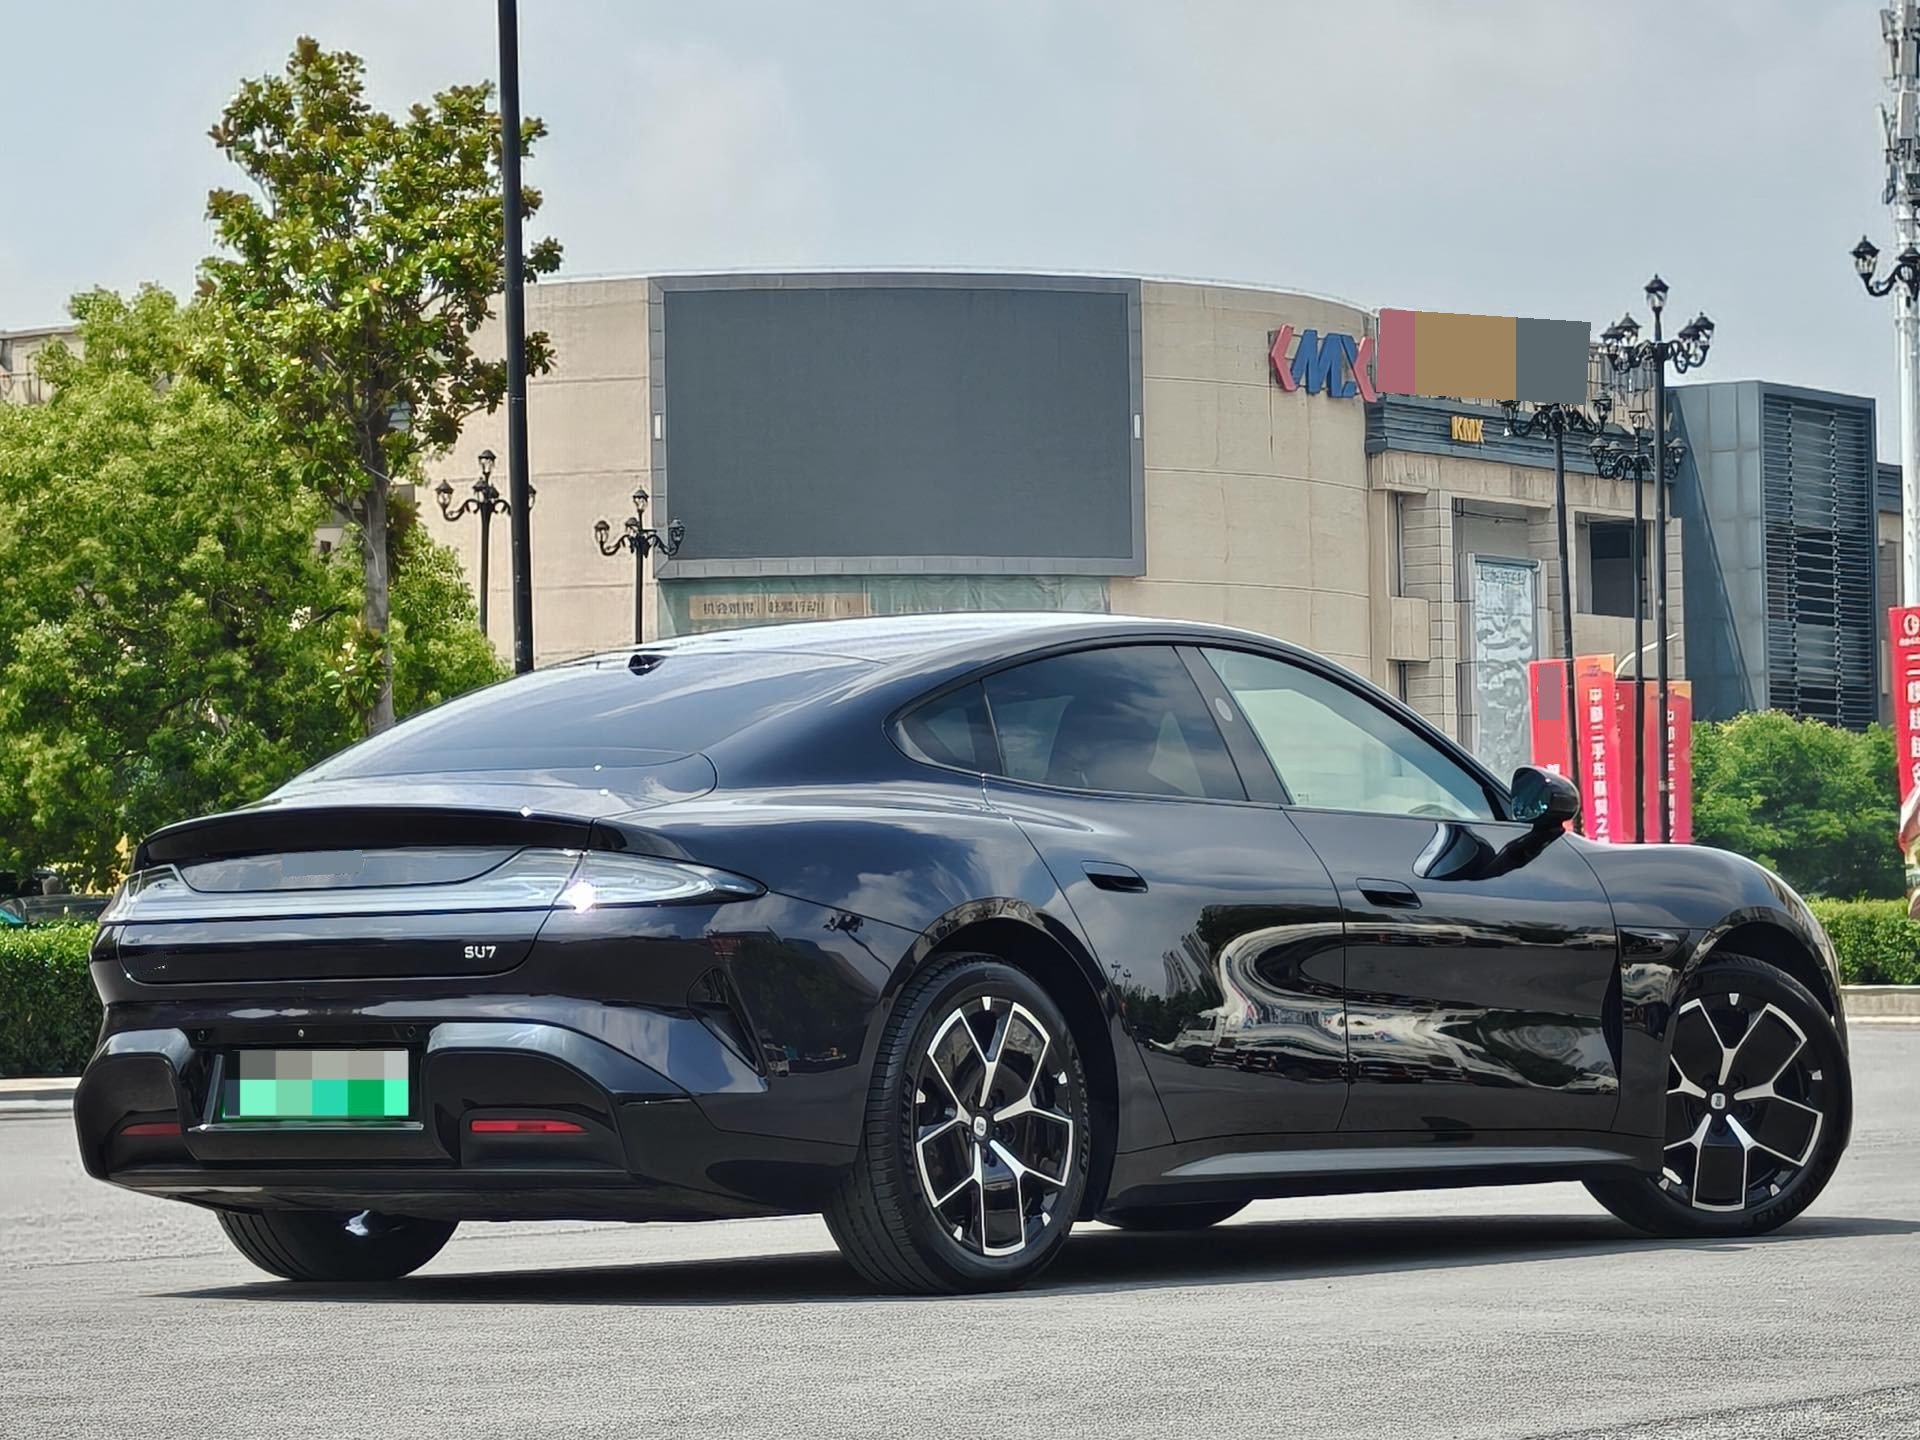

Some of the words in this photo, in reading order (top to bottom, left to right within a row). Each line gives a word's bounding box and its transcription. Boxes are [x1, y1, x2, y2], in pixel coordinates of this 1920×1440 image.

[1452, 415, 1485, 444] KMX
[464, 945, 497, 959] SU7
[1073, 1059, 1089, 1168] MICHELIN
